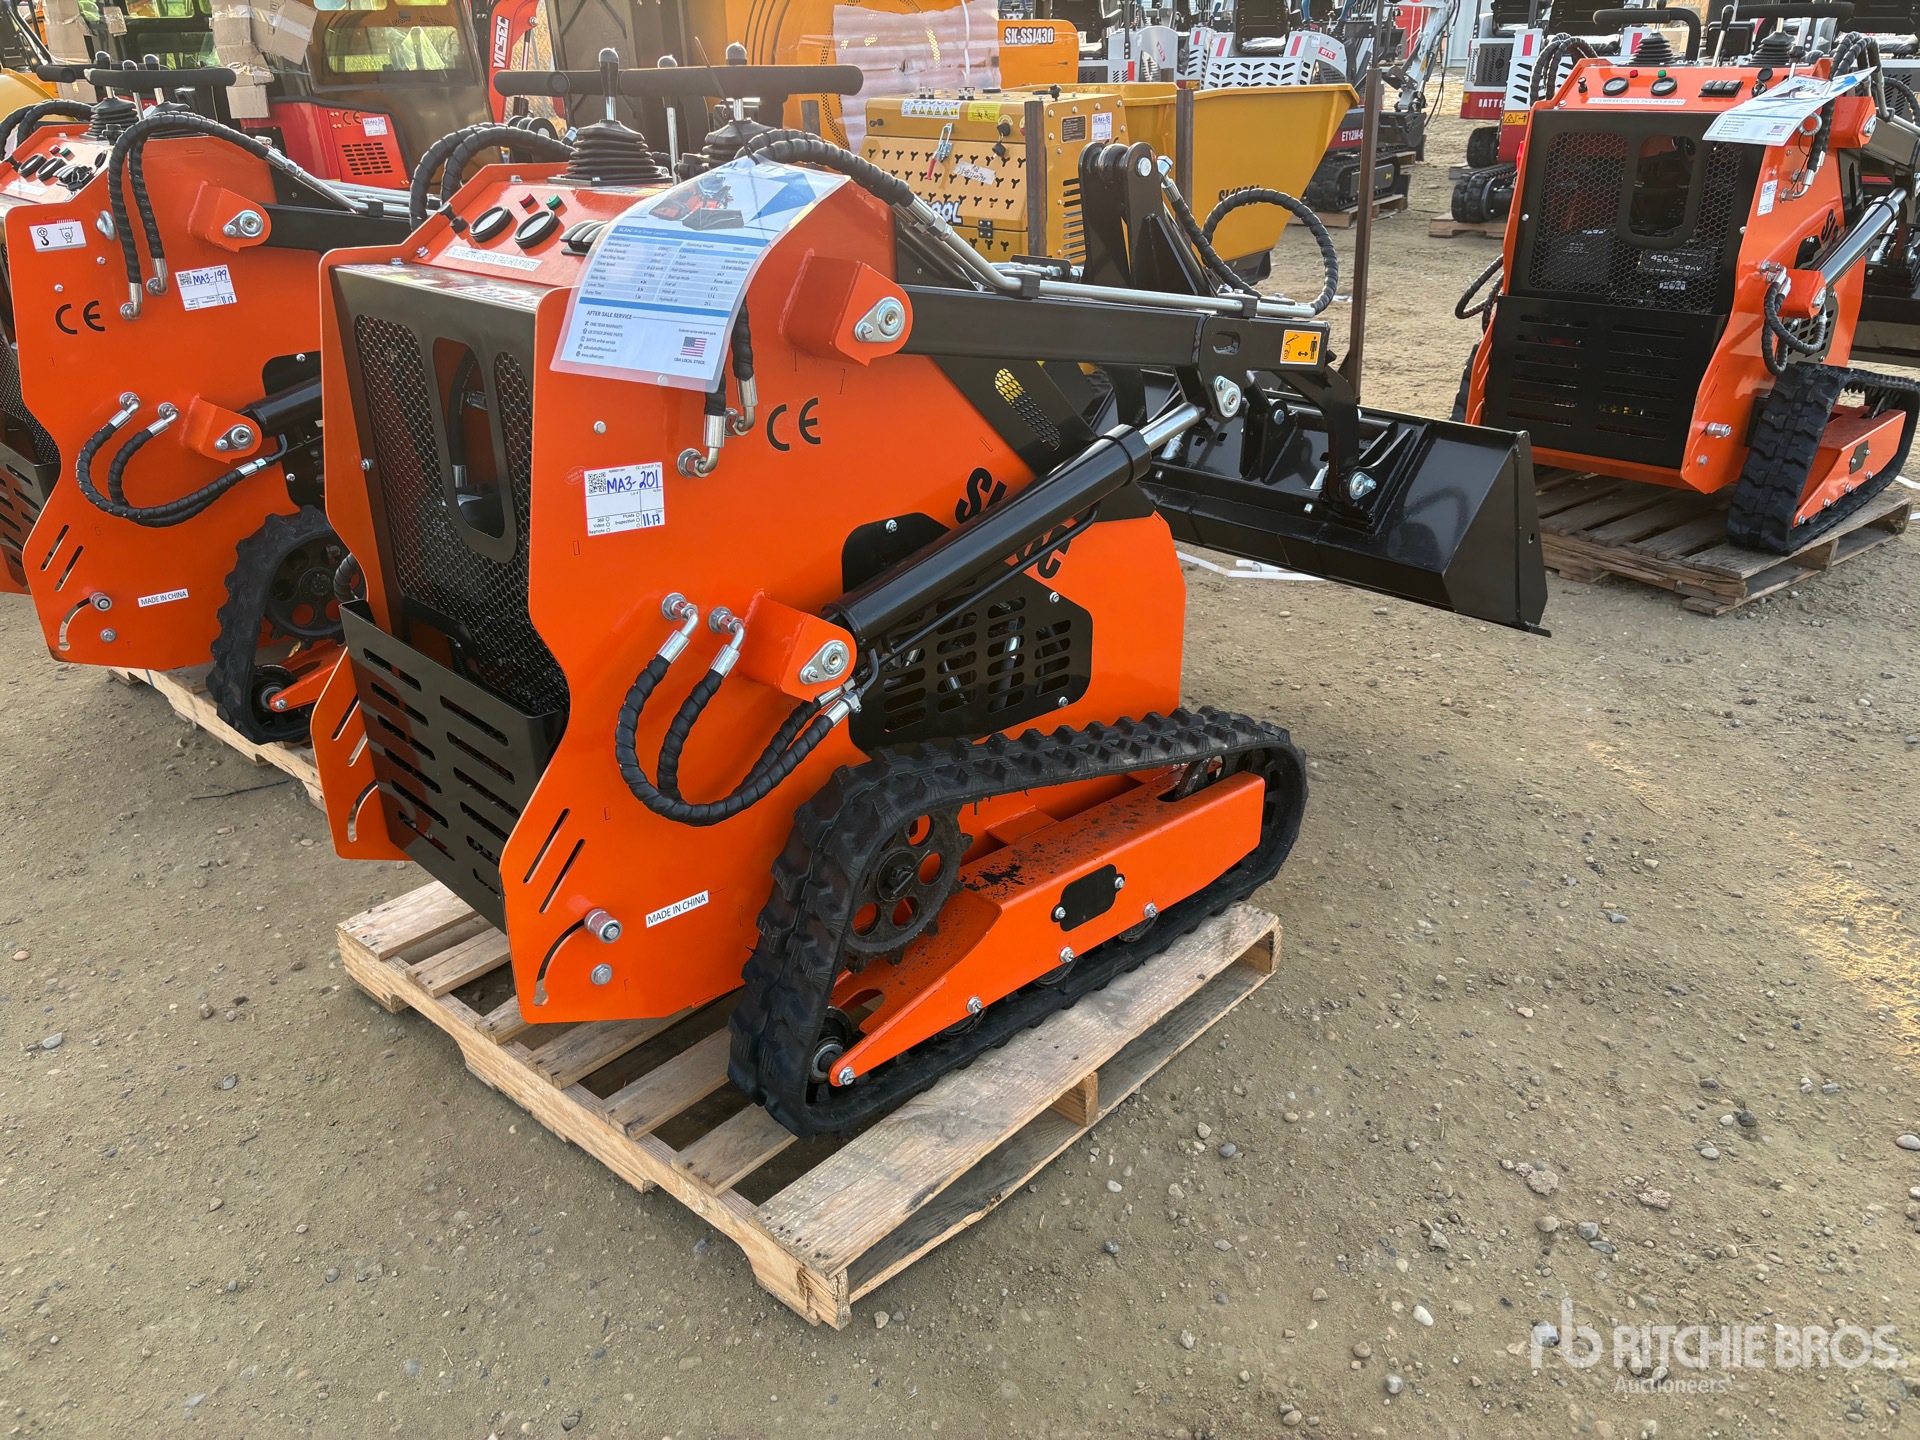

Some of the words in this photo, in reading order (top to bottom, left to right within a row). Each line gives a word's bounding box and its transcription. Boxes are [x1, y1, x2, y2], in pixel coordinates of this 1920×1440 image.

[1478, 98, 1503, 108] BATTL
[192, 269, 228, 286] MA3-199
[613, 312, 632, 320] SERVICE
[606, 469, 659, 494] MA3-201
[140, 594, 160, 606] MADE
[160, 593, 168, 601] IN
[167, 590, 187, 600] CHINA
[647, 907, 671, 925] MADE
[672, 904, 681, 914] IN
[682, 894, 707, 910] CHINA
